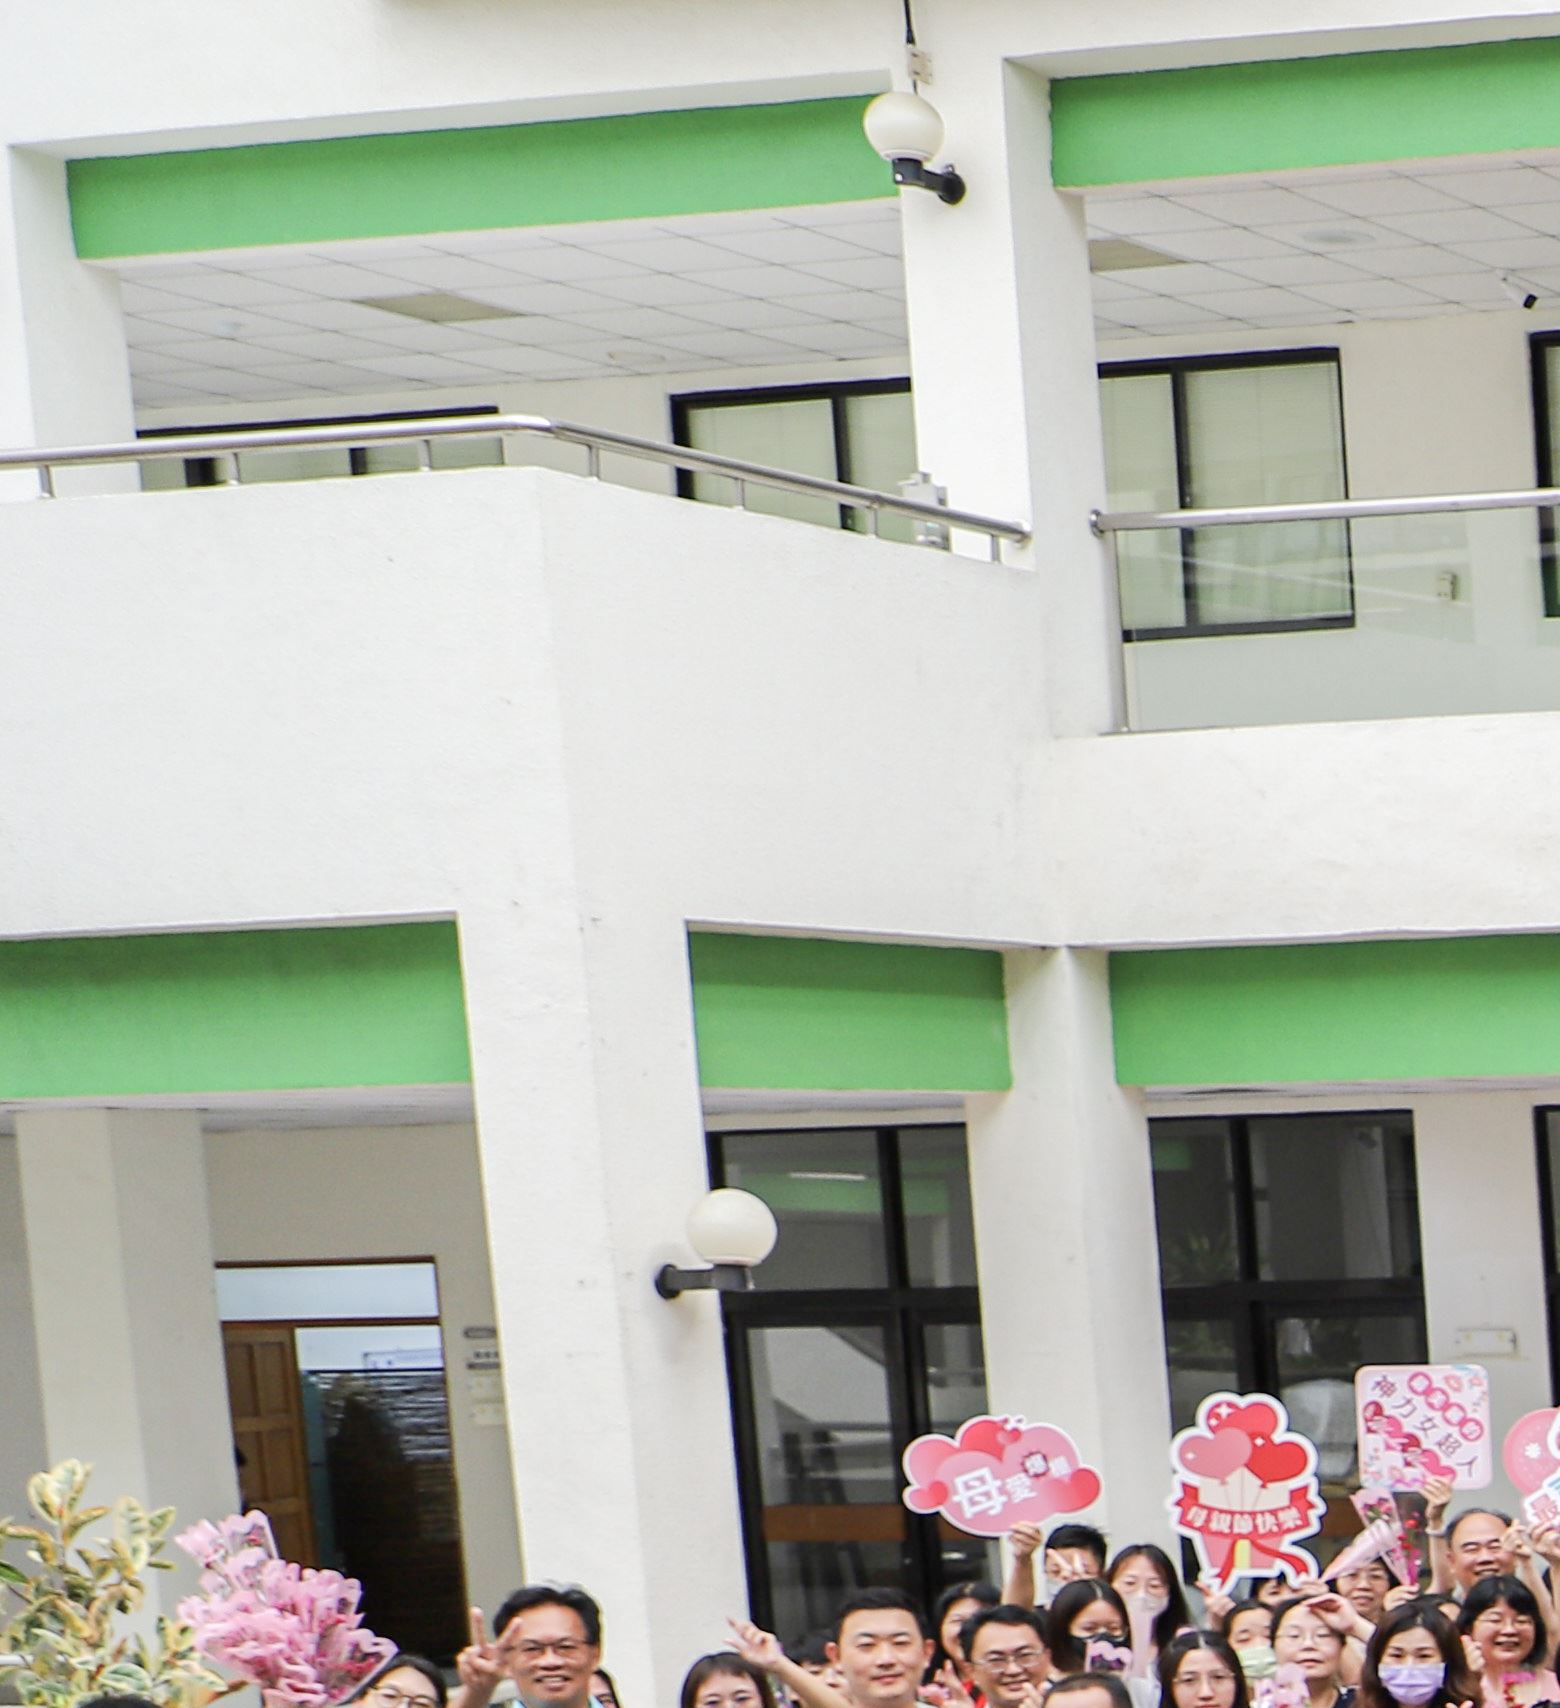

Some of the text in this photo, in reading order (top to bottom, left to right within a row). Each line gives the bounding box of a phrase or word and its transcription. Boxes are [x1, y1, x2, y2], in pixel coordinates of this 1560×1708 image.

[1371, 1374, 1479, 1478] 神力女超人
[1187, 1503, 1303, 1533] 母親節快樂
